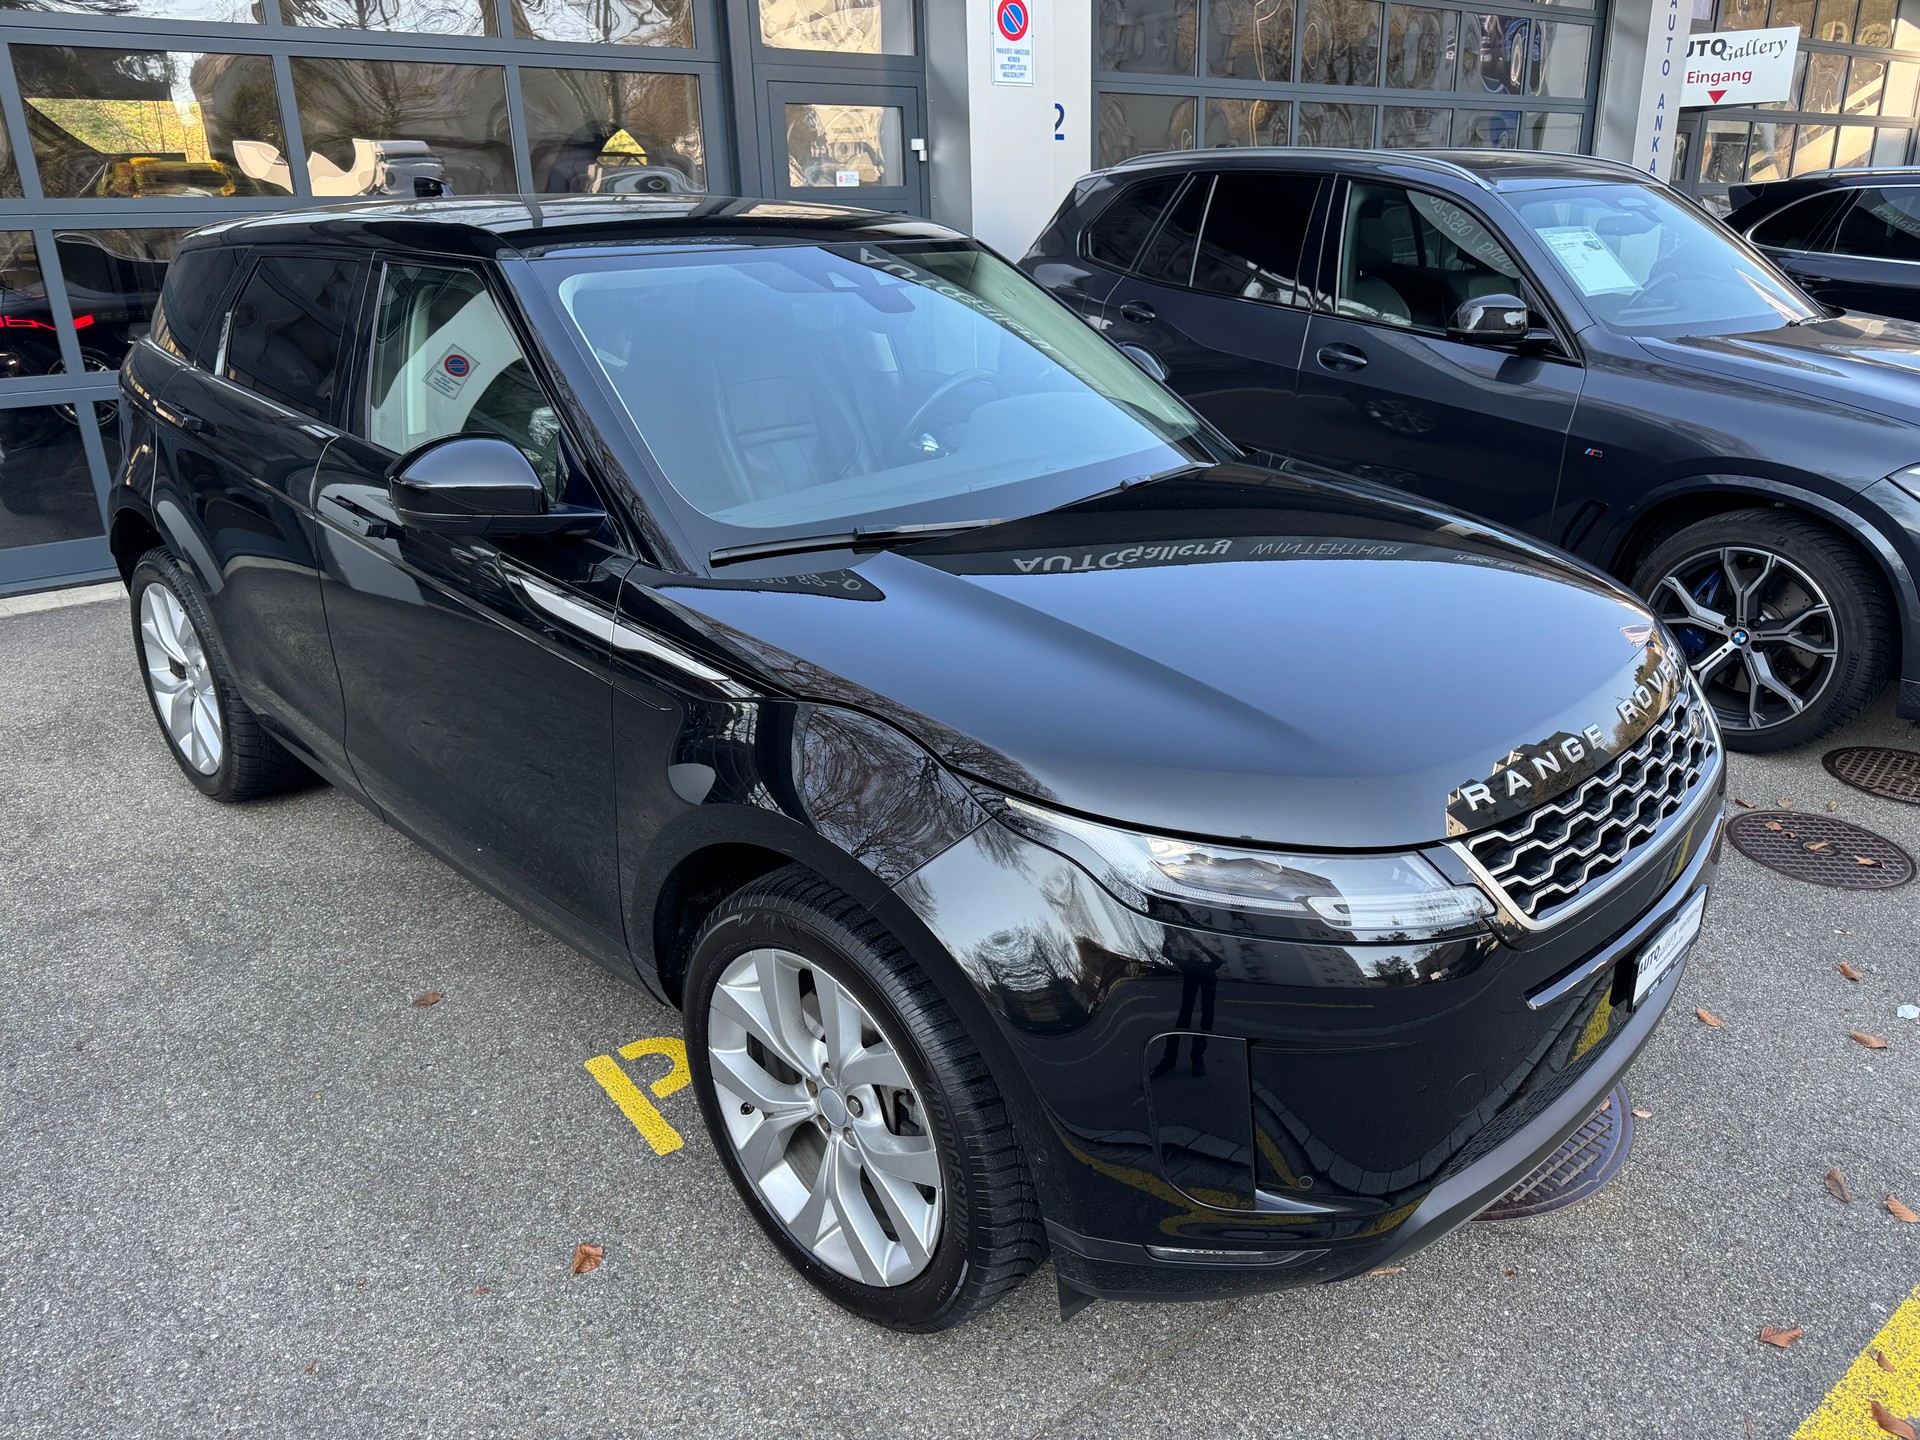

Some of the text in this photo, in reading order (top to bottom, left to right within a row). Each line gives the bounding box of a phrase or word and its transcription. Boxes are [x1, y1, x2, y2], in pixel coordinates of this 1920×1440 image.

[1686, 38, 1788, 62] UTOGallery
[1686, 70, 1753, 86] Eingang
[1616, 645, 1683, 725] ROVER
[1458, 723, 1606, 812] RANGE
